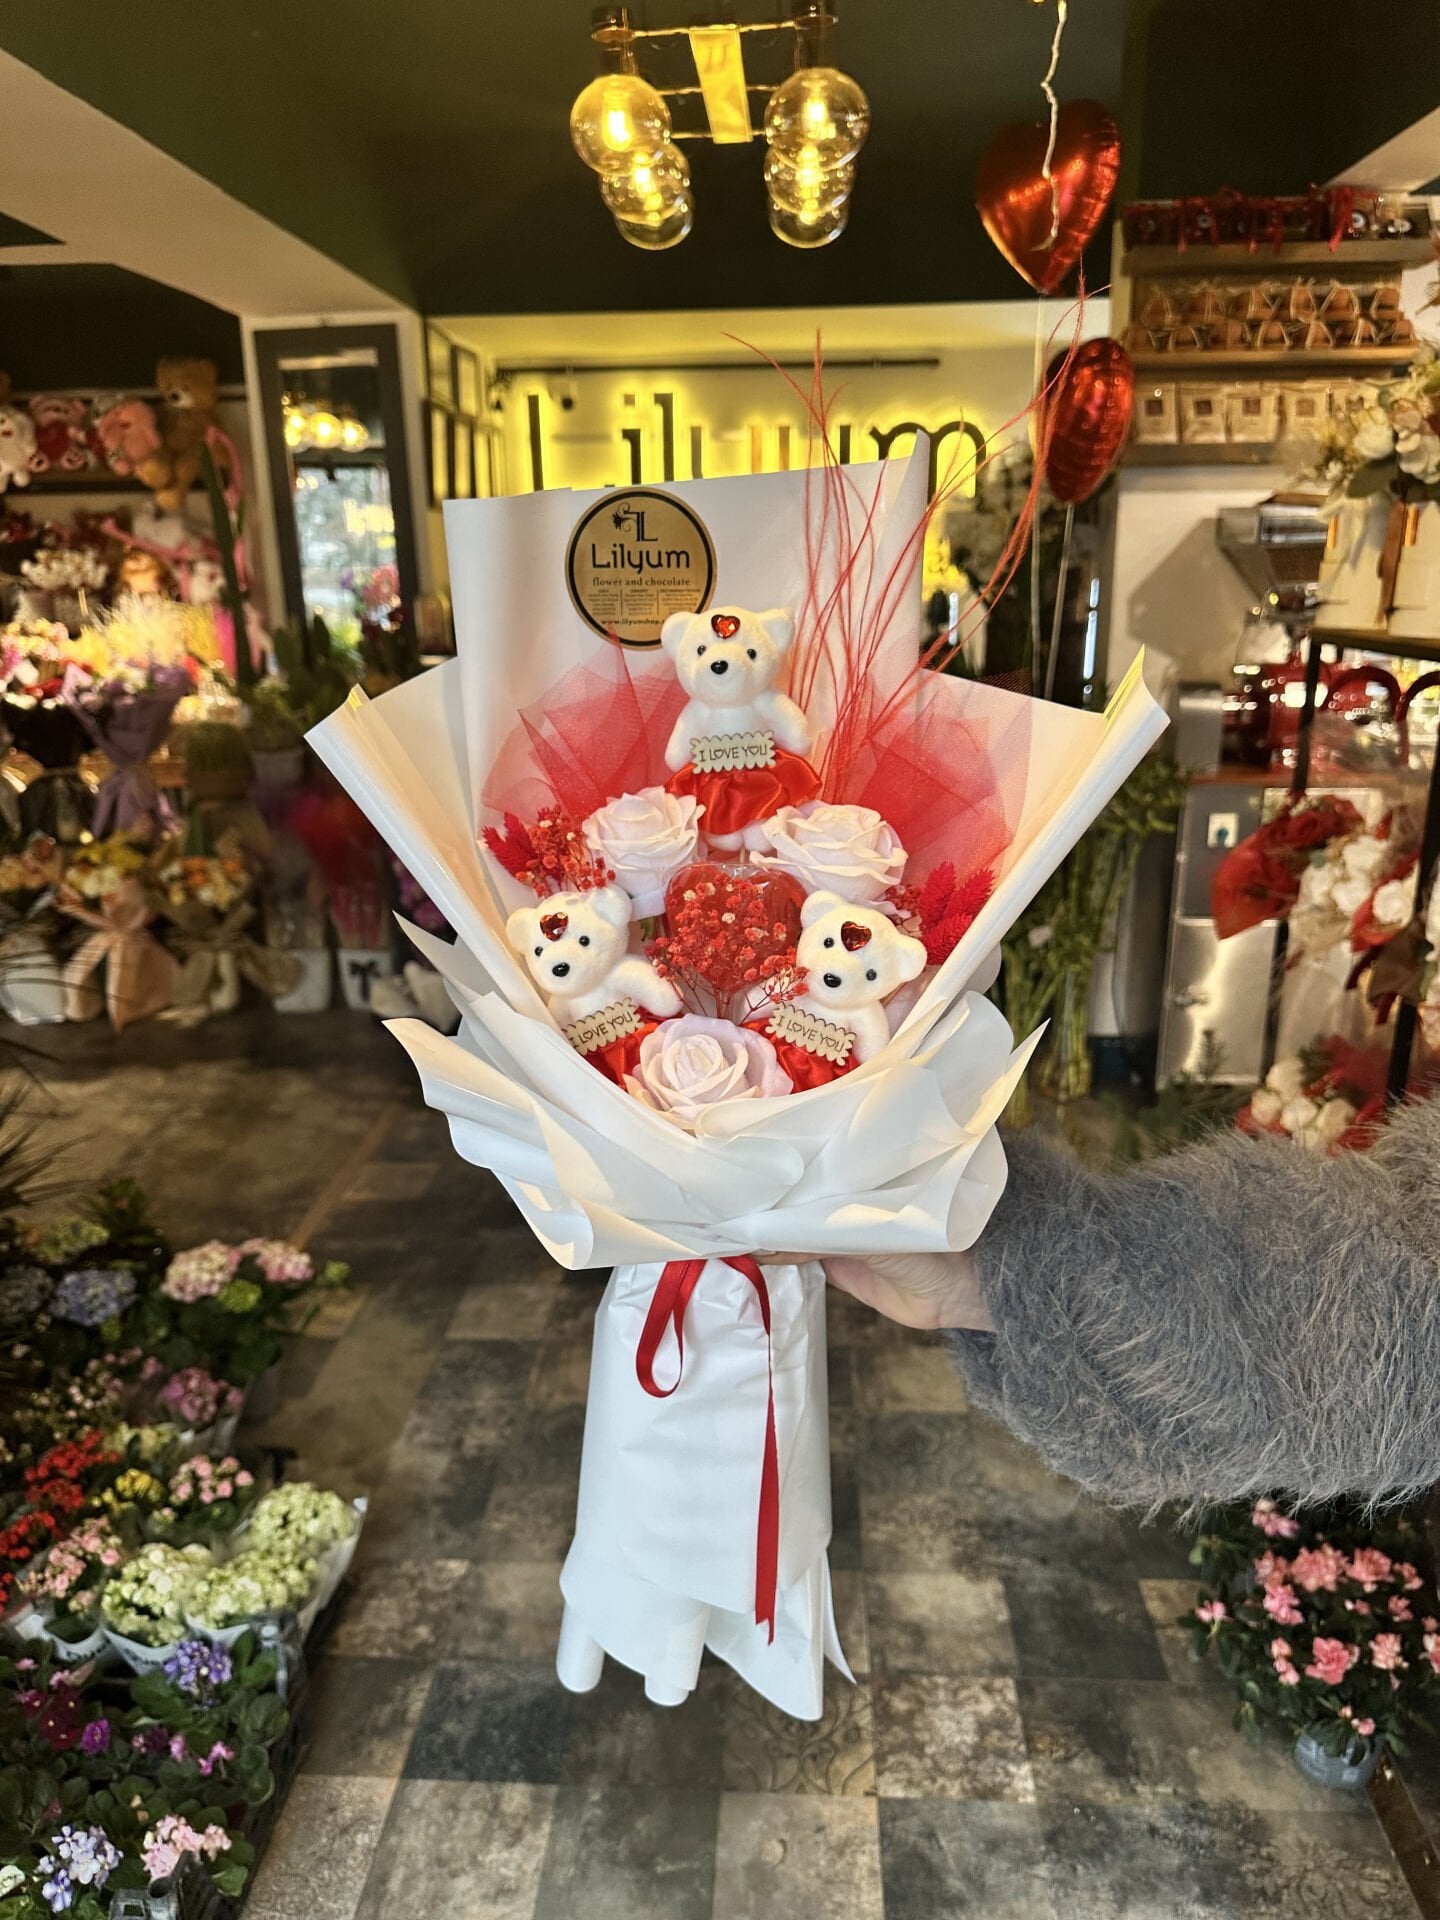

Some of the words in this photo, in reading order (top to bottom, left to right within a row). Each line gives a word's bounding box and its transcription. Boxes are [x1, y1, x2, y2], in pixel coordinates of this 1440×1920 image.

[592, 543, 690, 574] Lilyum
[592, 577, 622, 587] flower
[625, 577, 642, 587] and
[645, 577, 690, 587] chocolate
[699, 750, 706, 762] I
[777, 1015, 785, 1027] I
